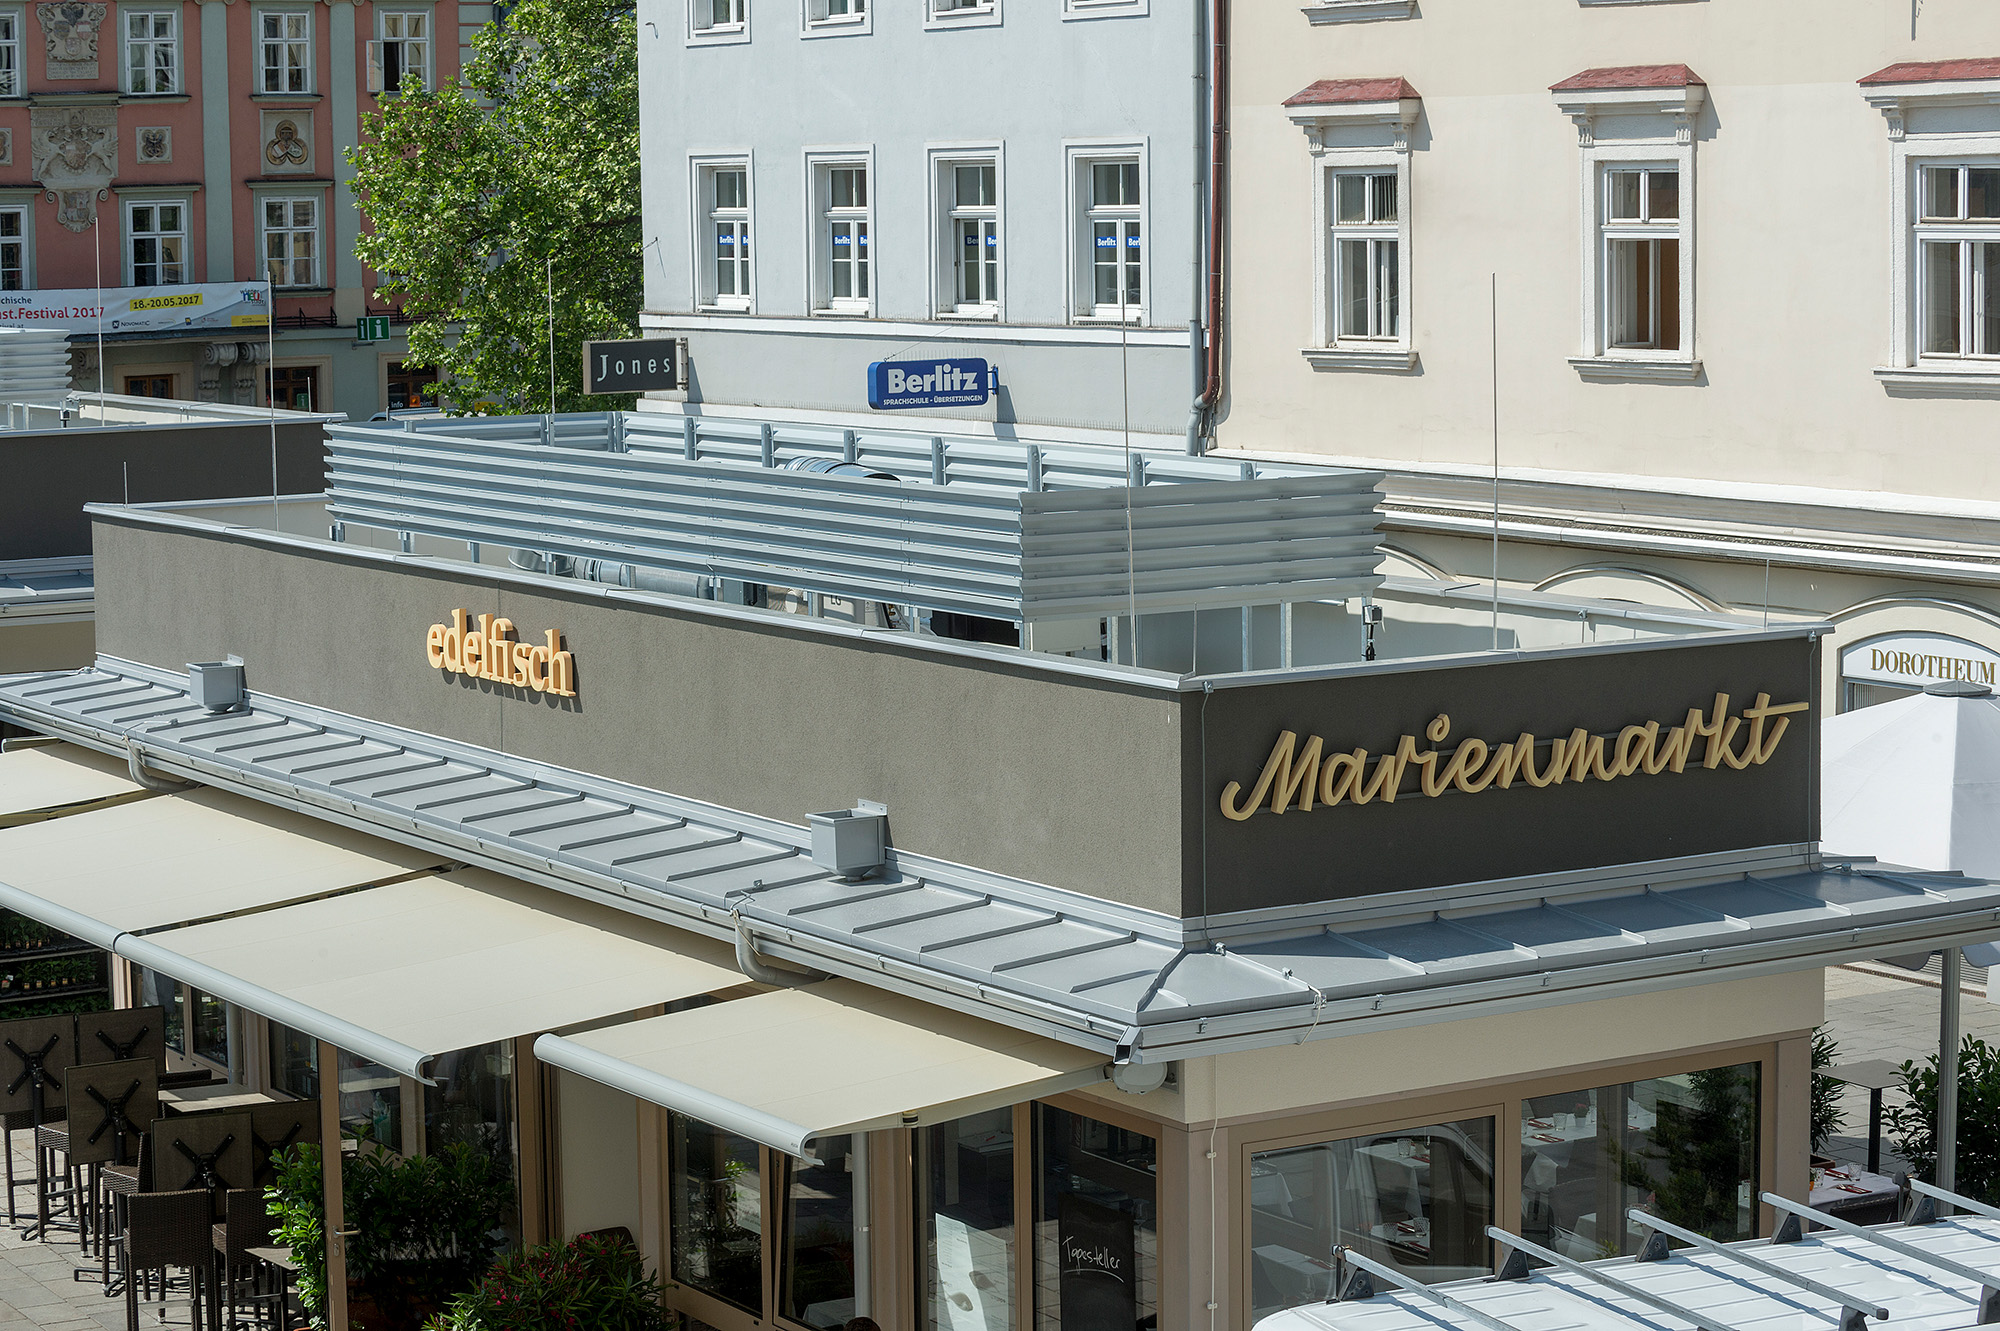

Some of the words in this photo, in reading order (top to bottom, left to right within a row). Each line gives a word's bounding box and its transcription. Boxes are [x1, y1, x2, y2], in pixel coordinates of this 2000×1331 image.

[1097, 238, 1117, 246] Berlitz
[1, 296, 32, 304] chische
[133, 295, 199, 310] 18.-20.05.2017
[0, 306, 70, 320] st.Festival
[72, 306, 105, 319] 2017
[596, 354, 671, 382] Jones
[887, 363, 979, 394] Berlitz
[391, 400, 404, 409] info
[883, 396, 930, 406] SPRACHSCHULE
[933, 395, 983, 404] ÜBERSETZUNGEN
[427, 608, 576, 697] edelfisch
[1870, 648, 1996, 685] DOROTHEUM
[1220, 692, 1810, 822] Marienmarkt
